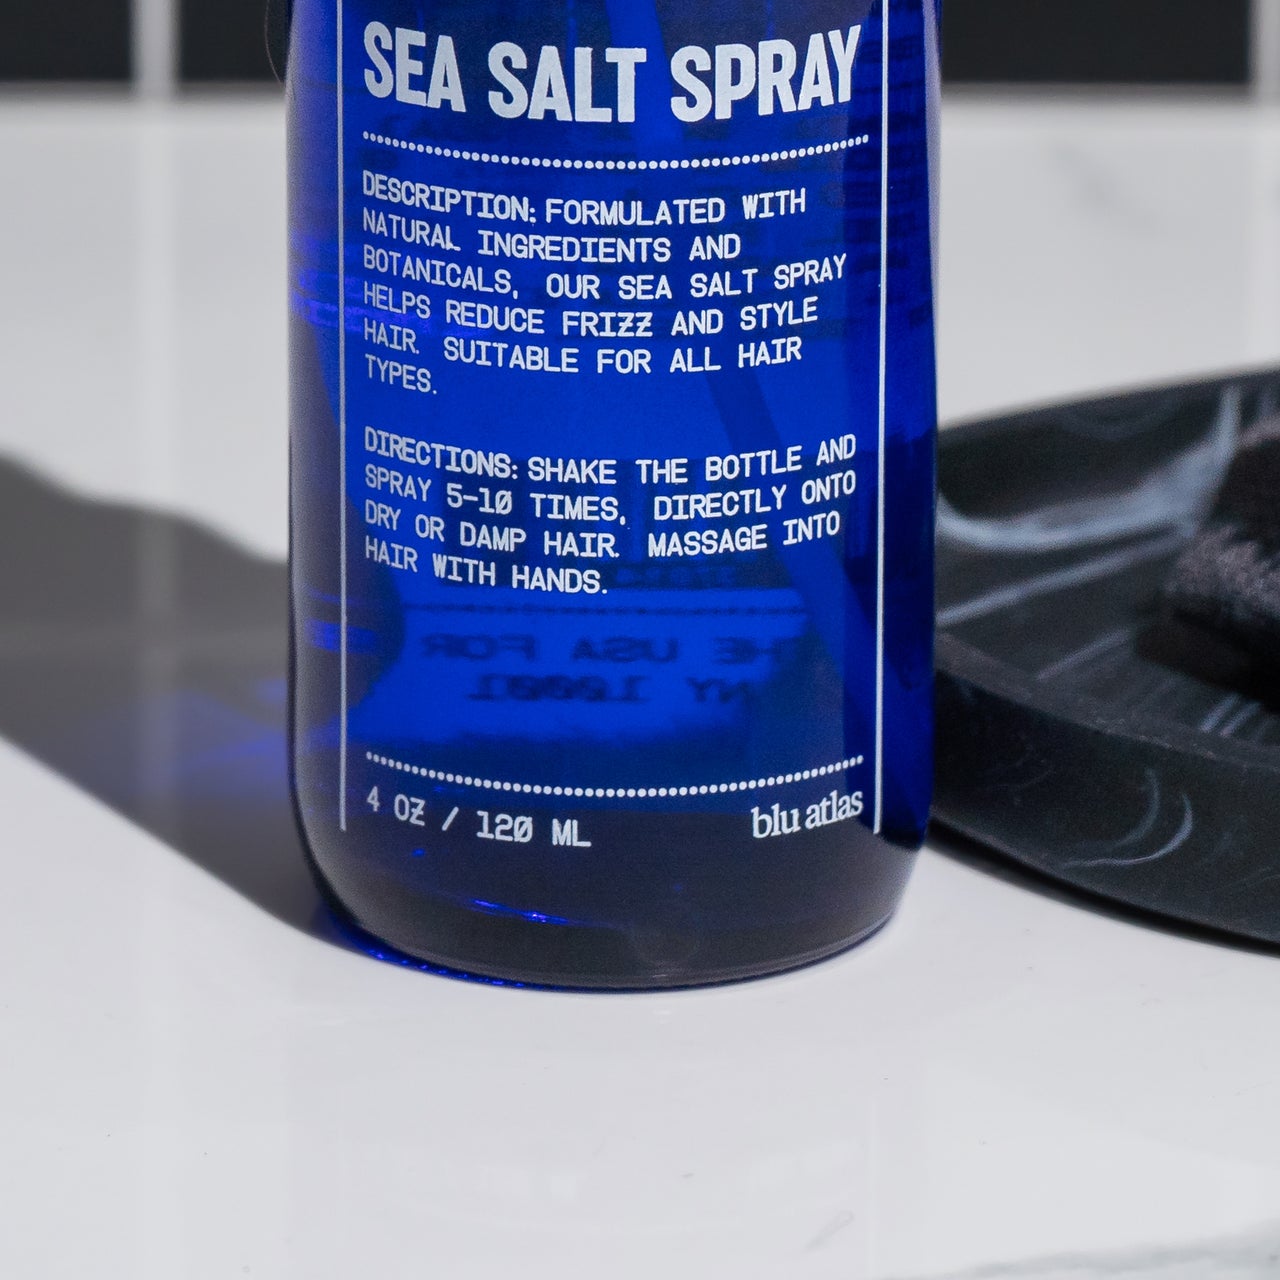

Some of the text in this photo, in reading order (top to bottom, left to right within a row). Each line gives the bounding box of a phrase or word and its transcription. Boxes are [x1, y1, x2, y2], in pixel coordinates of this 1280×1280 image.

[364, 22, 862, 123] SEA SALT SPRAY
[363, 170, 806, 226] DESCRIPTION: FORMULATED WITH
[363, 207, 741, 263] NATURAL INGREDIENTS AND
[363, 244, 847, 301] BOTANICALS, OUR SEA SALT SPRAY
[364, 281, 819, 338] HELPS REDUCE FRIZZ AND STYLE
[364, 317, 803, 375] HAIR. SUITABLE FOR ALL HAIR
[365, 353, 438, 395] TYPES.
[364, 426, 857, 485] DIRECTIONS: SHAKE THE BOTTLE AND
[365, 463, 857, 526] SPRAY 5-10 TIMES, DIRECTLY ONTO
[365, 499, 841, 558] DRY OR DAMP HAIR. MASSAGE INTO
[365, 535, 418, 573] HAIR
[432, 552, 496, 587] WITH
[511, 564, 608, 595] HANDS.
[366, 785, 592, 848] 4 OZ / 120 ML
[750, 789, 864, 839] blu atlas
